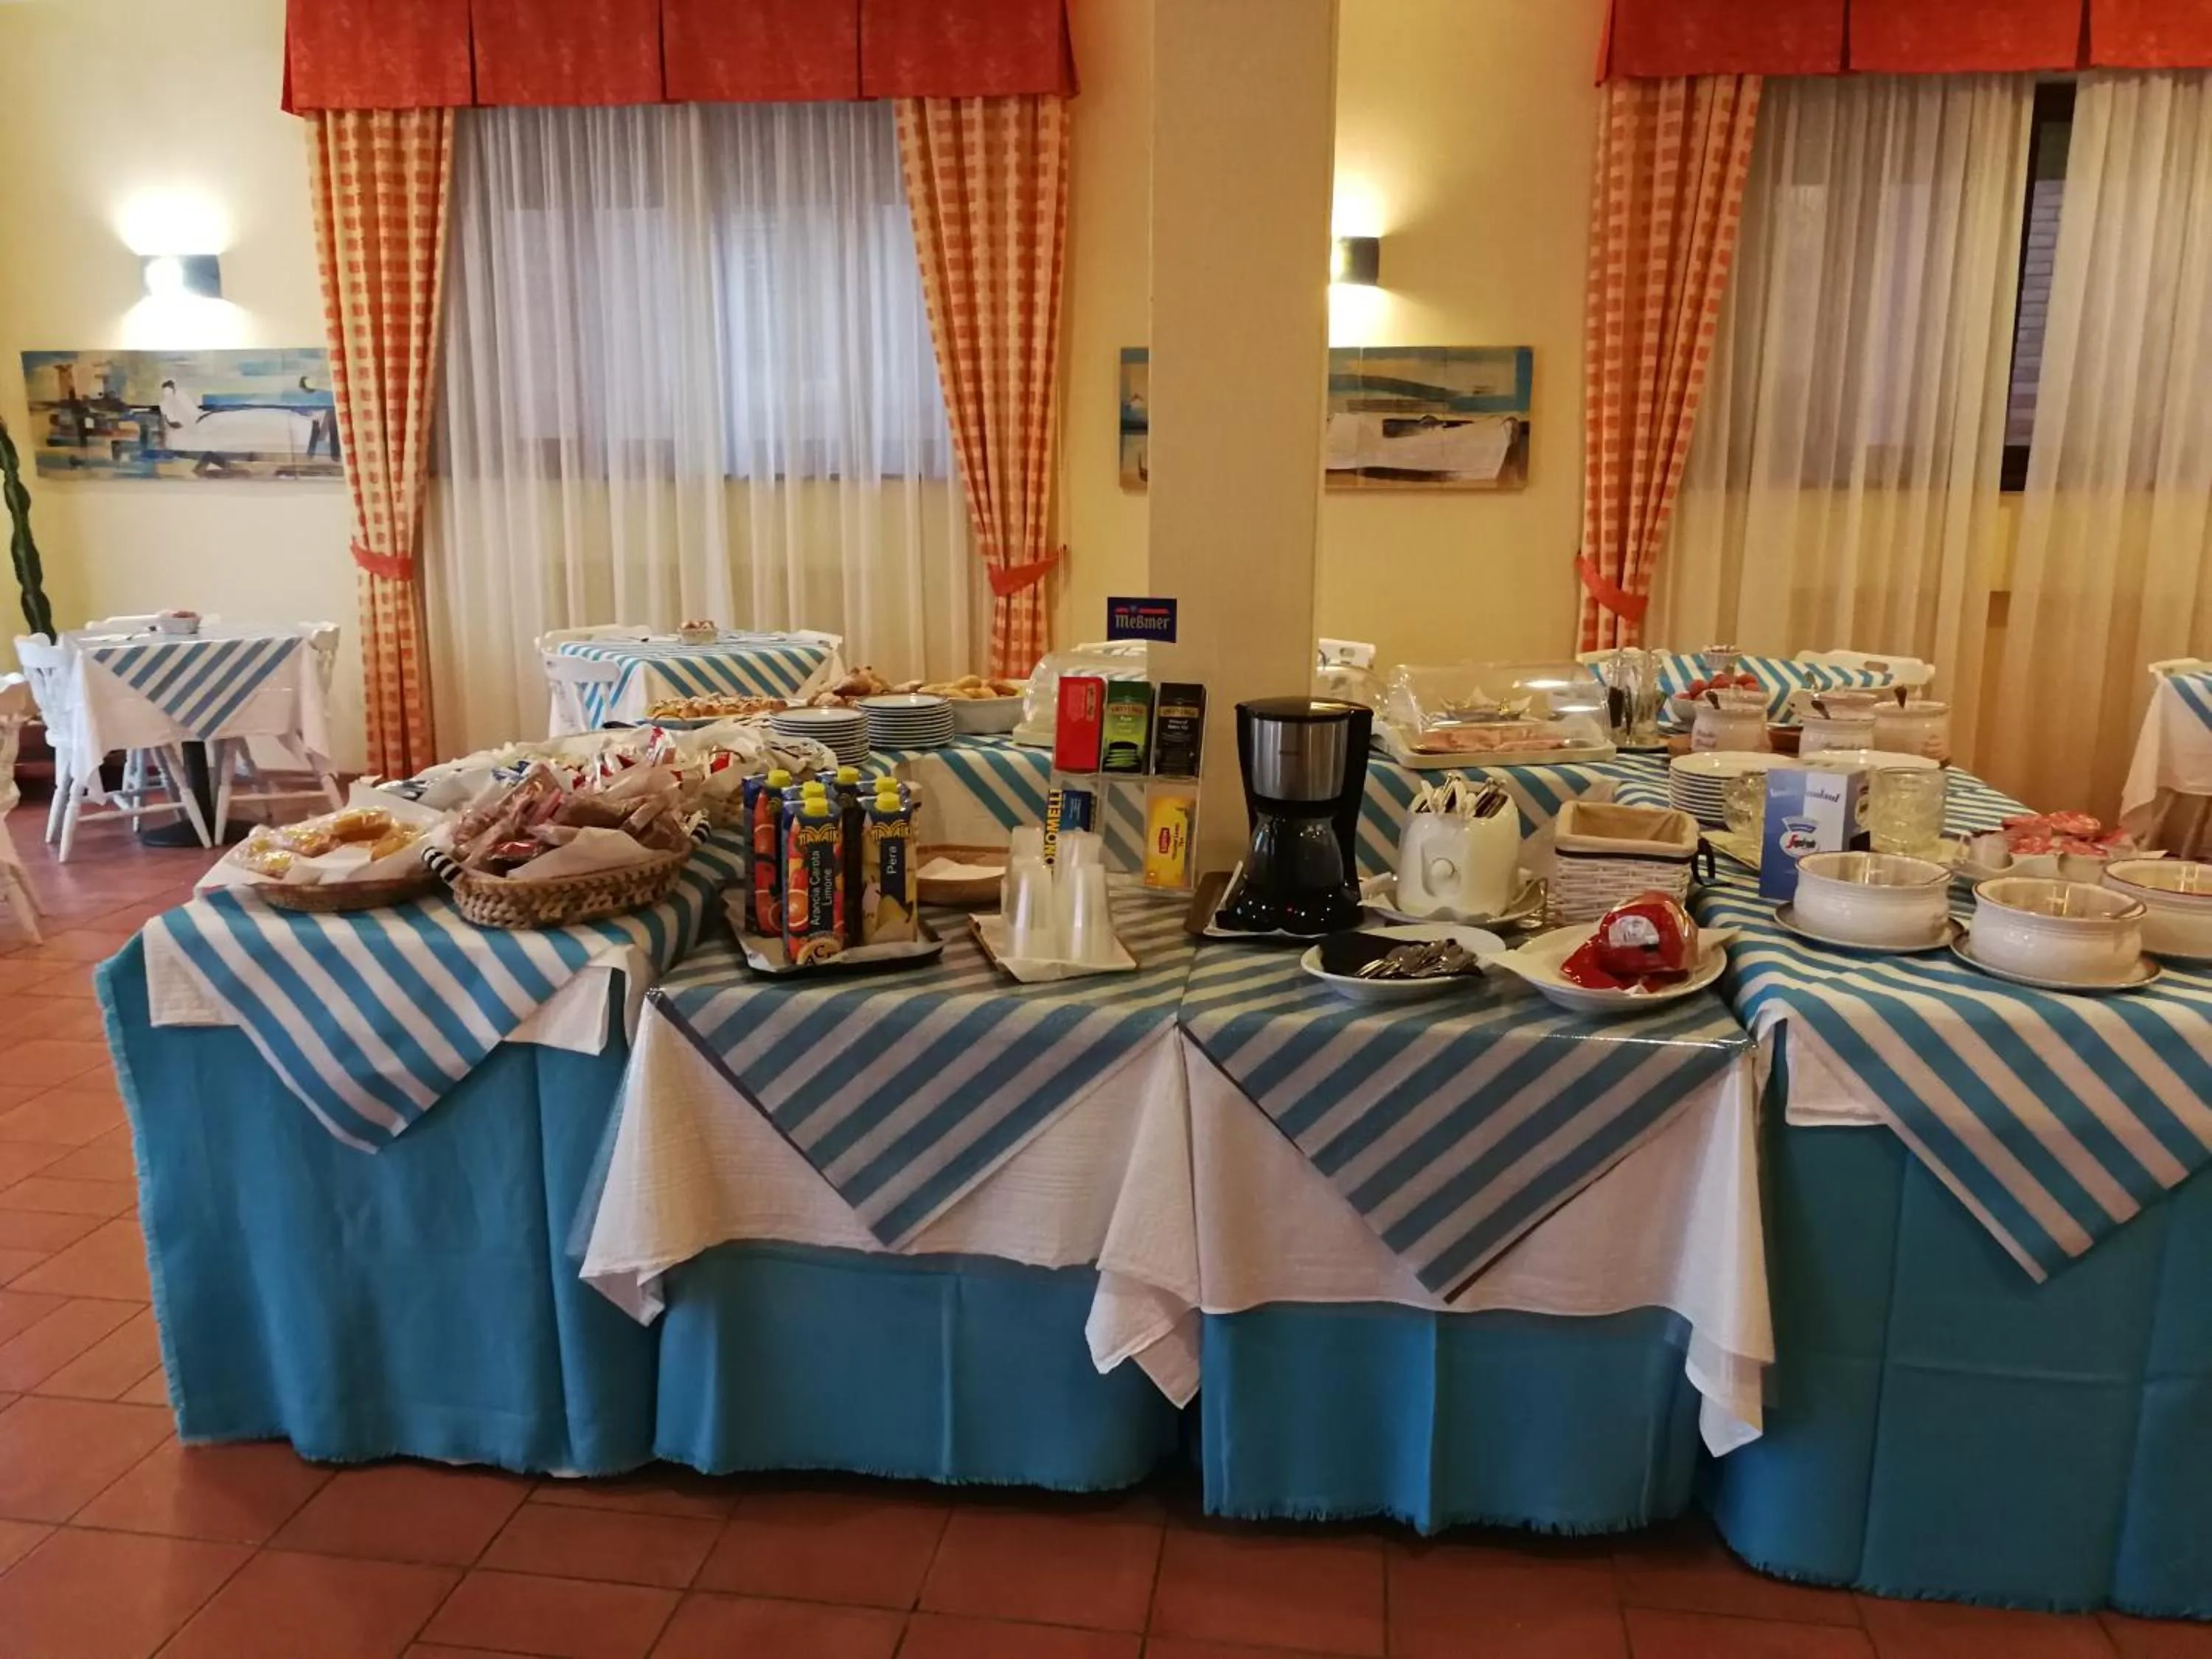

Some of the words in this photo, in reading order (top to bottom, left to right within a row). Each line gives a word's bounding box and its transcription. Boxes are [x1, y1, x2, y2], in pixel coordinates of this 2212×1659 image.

[1044, 789, 1062, 866] ONOMELLI
[810, 850, 821, 885] Carota
[887, 846, 897, 874] Pera
[822, 868, 832, 906] Limone
[810, 887, 821, 925] Arancia
[804, 945, 831, 965] AC
